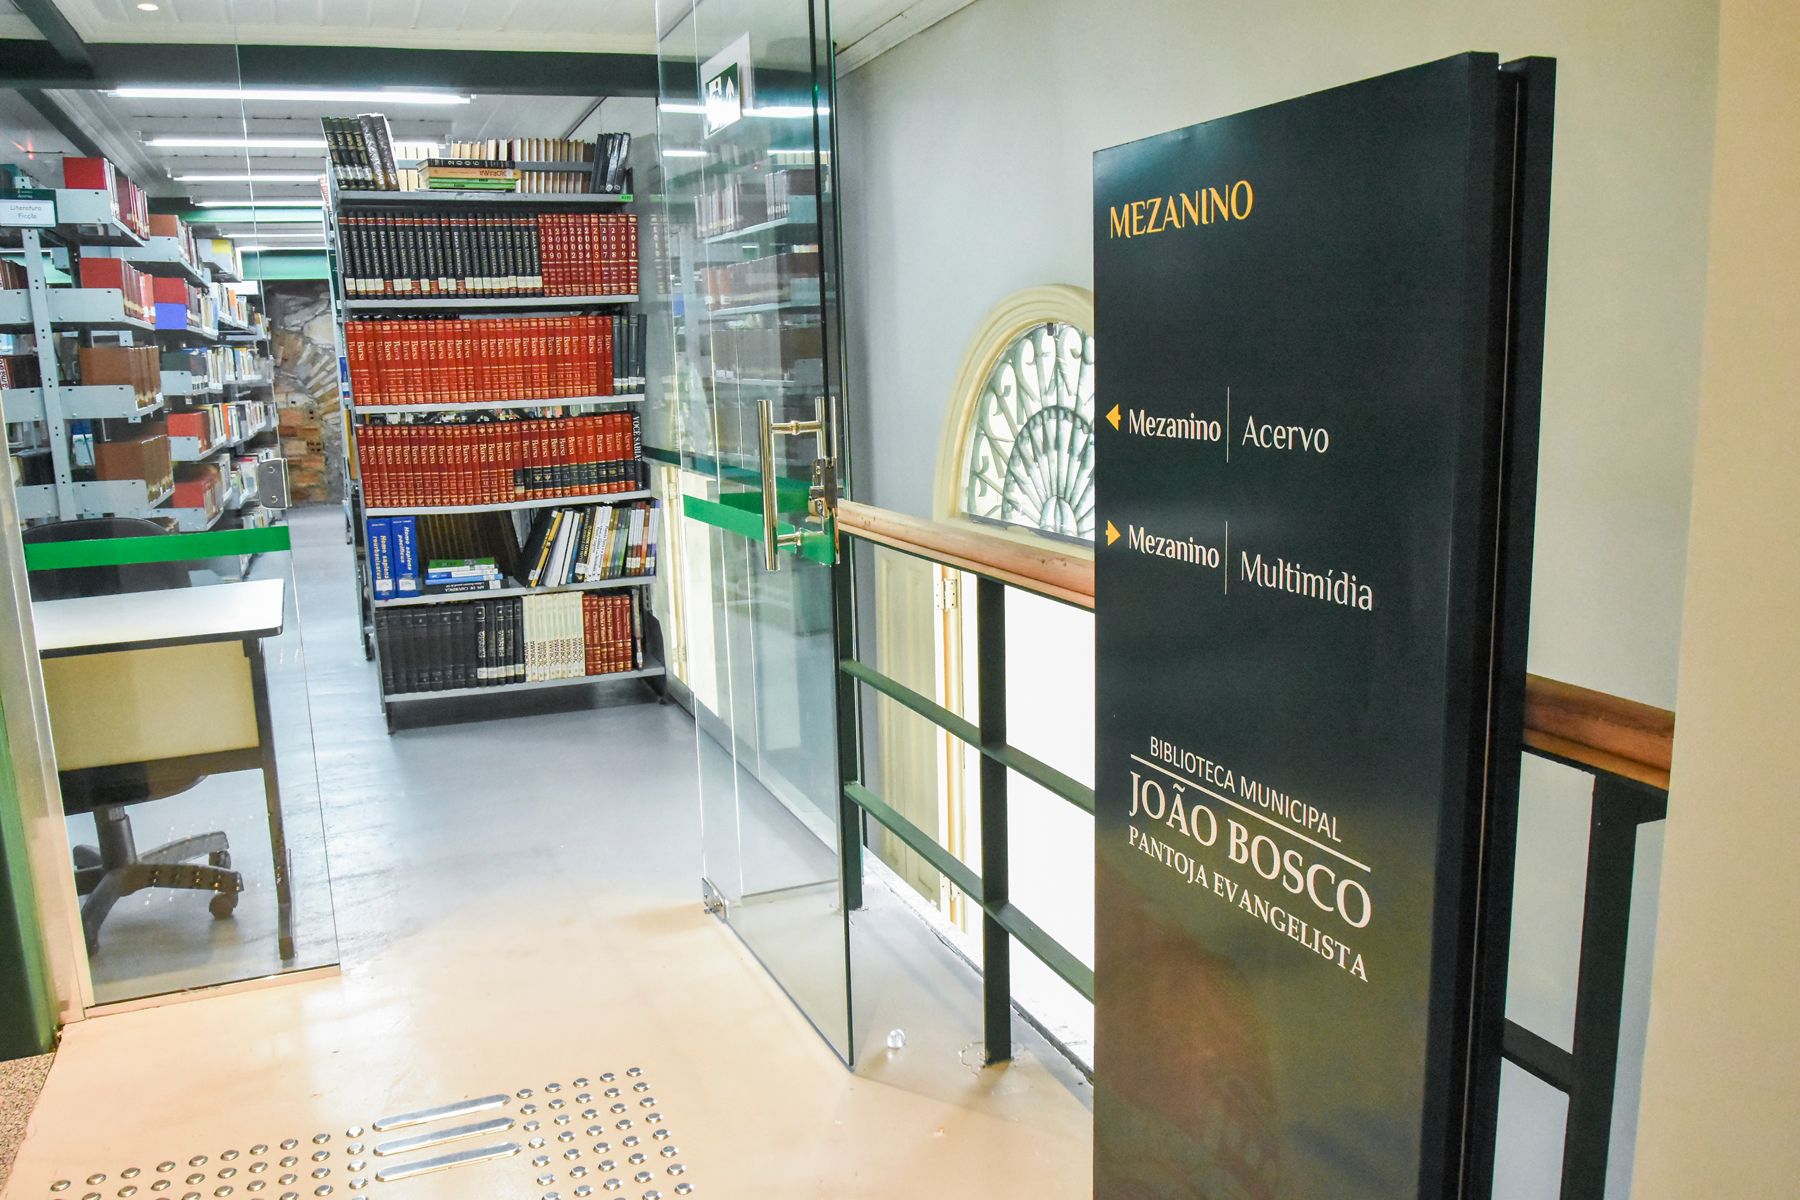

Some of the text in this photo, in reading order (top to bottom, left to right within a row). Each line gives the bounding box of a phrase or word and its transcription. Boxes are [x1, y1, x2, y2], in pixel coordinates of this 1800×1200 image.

[1109, 180, 1253, 239] MEZANINO
[632, 416, 642, 461] VOCÊ SABIA?
[1129, 409, 1329, 454] Mezanino Acervo
[1128, 525, 1373, 612] Mezanino Multimídia
[1150, 736, 1342, 843] BIBLIOTECA MUNICIPAL
[1129, 771, 1372, 929] JOÃO BOSCO
[1129, 825, 1368, 982] PANTOJA EVANGELISTA
